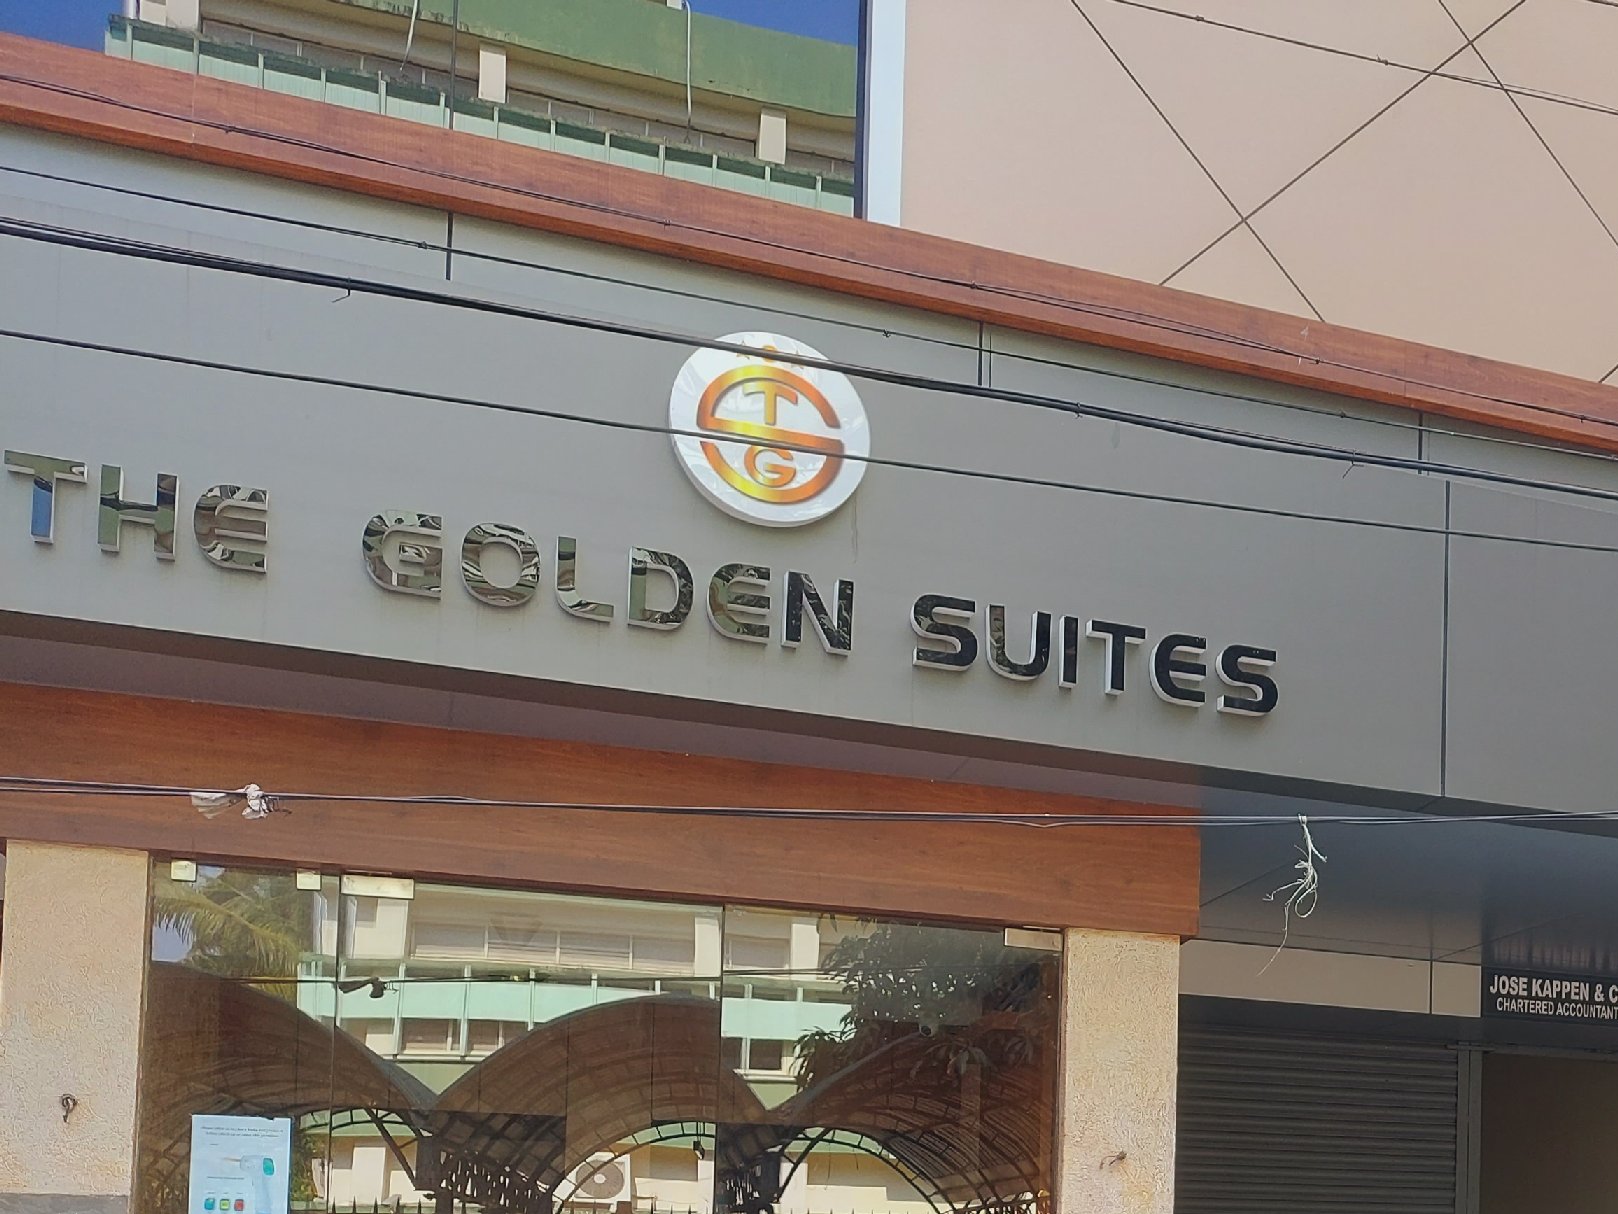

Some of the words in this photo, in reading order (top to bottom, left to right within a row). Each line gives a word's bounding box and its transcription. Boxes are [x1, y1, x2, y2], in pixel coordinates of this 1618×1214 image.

[4, 449, 270, 575] THE
[361, 508, 856, 657] GOLDEN
[910, 593, 1279, 717] SUITES
[1489, 974, 1529, 997] JOSE
[1531, 978, 1590, 1001] KAPPEN
[1594, 983, 1605, 1002] &
[1496, 997, 1555, 1016] CHARTERED
